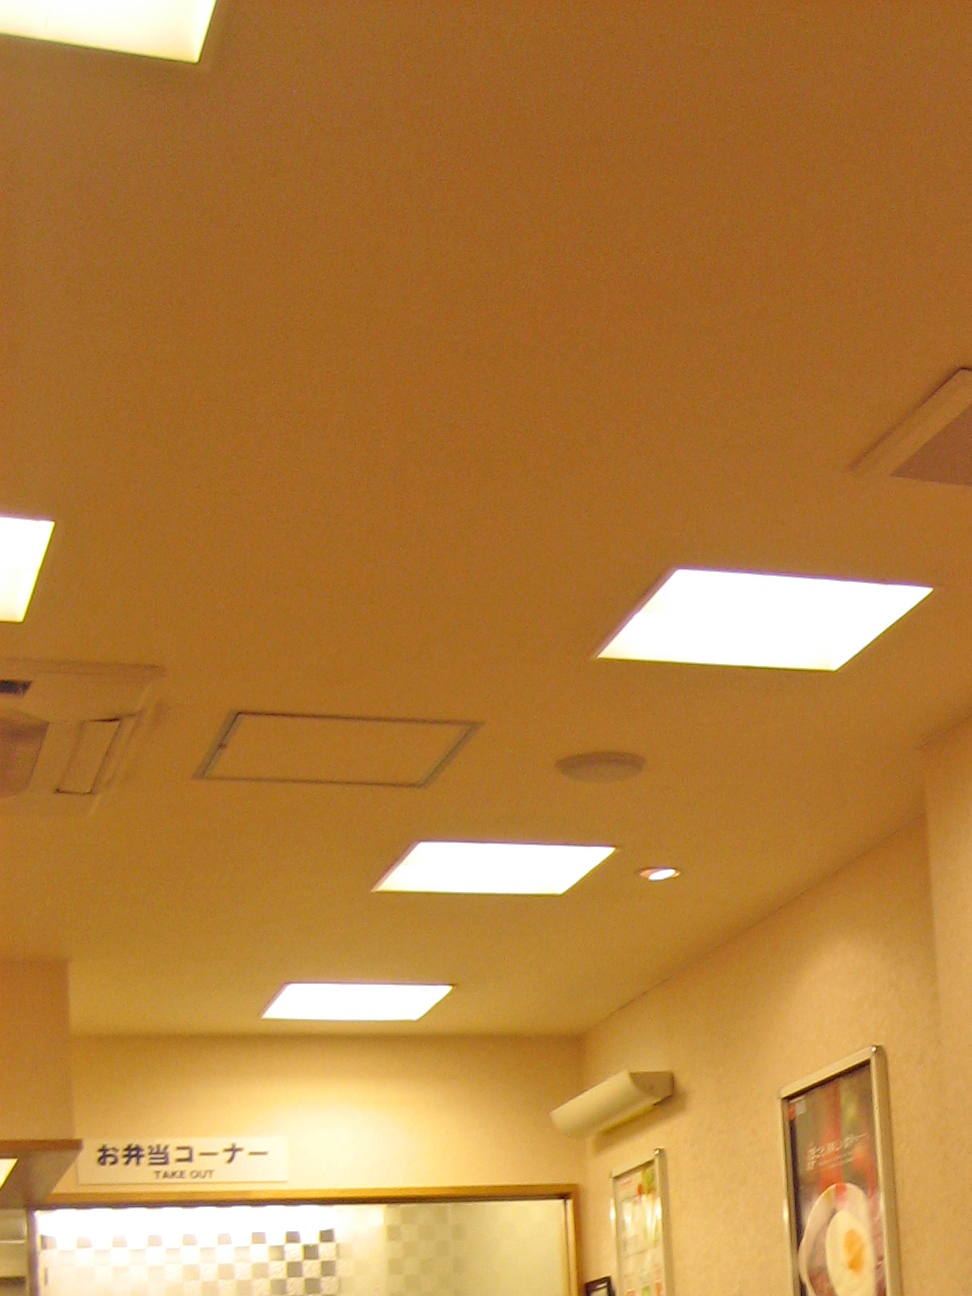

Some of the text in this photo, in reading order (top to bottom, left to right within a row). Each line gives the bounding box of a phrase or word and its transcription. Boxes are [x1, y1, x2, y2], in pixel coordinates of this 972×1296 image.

[97, 1143, 268, 1166] お弁当コーナー
[154, 1169, 215, 1180] TAKE OUT
